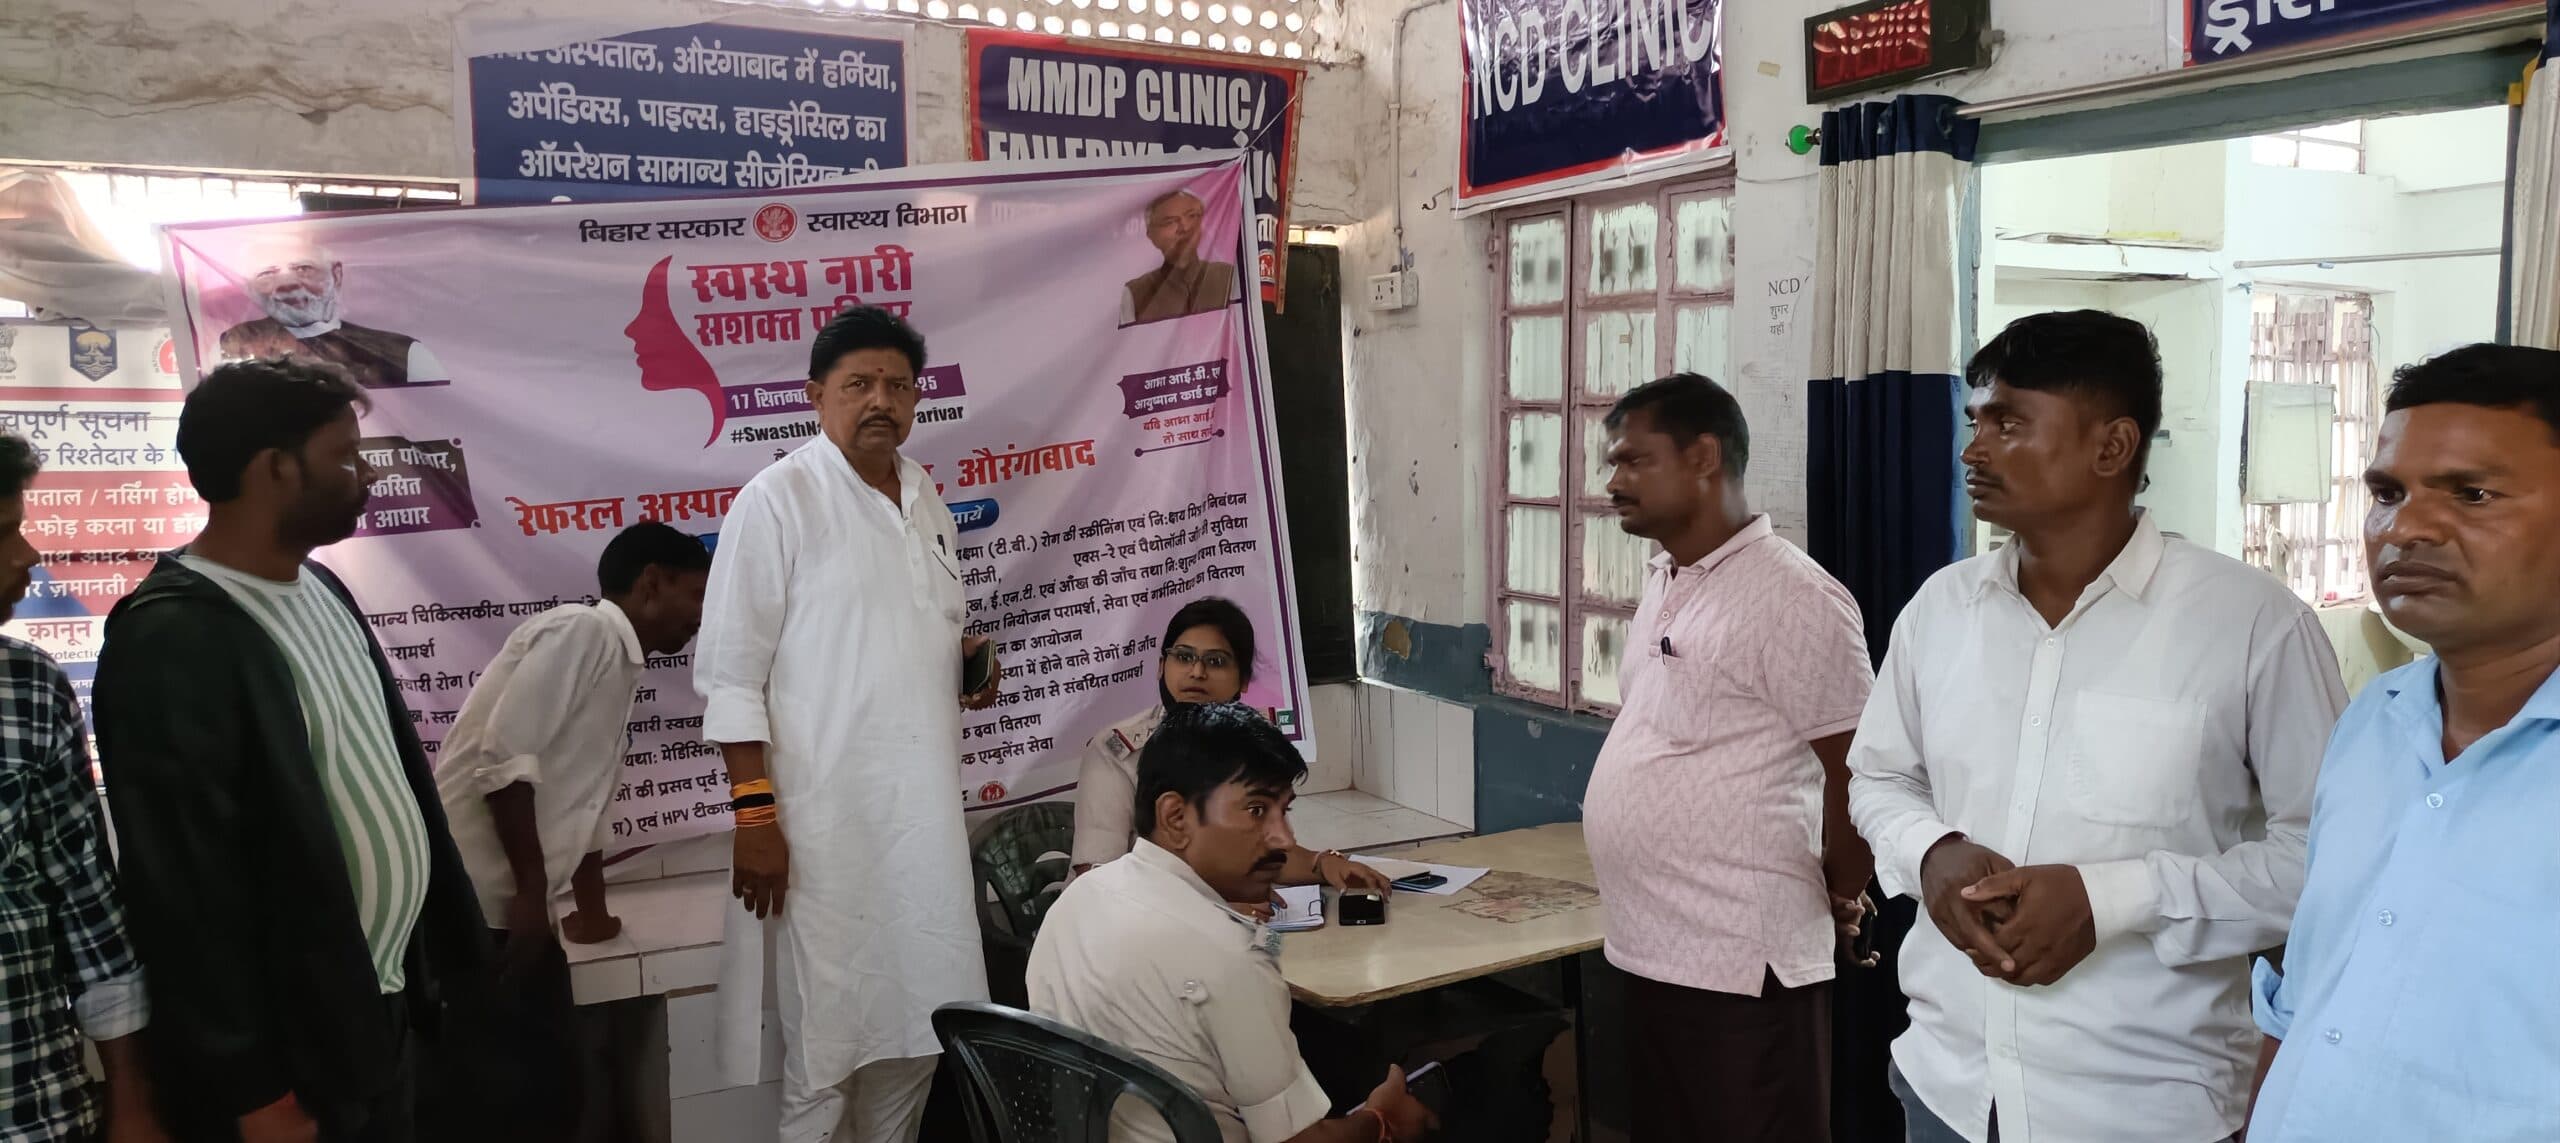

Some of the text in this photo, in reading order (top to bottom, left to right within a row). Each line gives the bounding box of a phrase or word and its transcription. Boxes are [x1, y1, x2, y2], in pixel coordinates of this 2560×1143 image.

[672, 36, 789, 81] औरंगाबाद
[795, 48, 819, 84] में
[821, 50, 897, 93] हर्निया,
[1471, 5, 1547, 120] NCD
[1008, 57, 1127, 118] MMDP
[638, 99, 726, 133] पाइल्स,
[733, 100, 851, 147] हाइड्रोसिल
[855, 115, 887, 142] का
[519, 140, 631, 181] ऑपरेशन
[637, 155, 728, 186] सामान्य
[579, 202, 968, 243] बिहार सरकार स्वास्थ्य विभाग
[687, 244, 914, 303] स्वस्थ नारी
[1768, 277, 1801, 297] NCD
[694, 308, 802, 347] सशक्त
[731, 393, 749, 410] 17
[78, 411, 152, 440] सूचना
[57, 442, 139, 466] रिश्तेदार
[144, 444, 165, 466] के
[105, 481, 159, 507] नर्सिंग
[505, 496, 625, 537] रेफरल
[958, 439, 1096, 488] औरंगाबाद
[86, 518, 137, 536] करना
[144, 519, 165, 535] या
[374, 506, 431, 529] आधार
[988, 536, 1038, 560] (टी.बी.)
[1040, 531, 1061, 548] रोग
[1063, 525, 1077, 543] की
[1078, 518, 1126, 541] स्क्रीनिंग
[1127, 513, 1147, 533] एवं
[1207, 491, 1248, 511] निबंधन
[1073, 543, 1116, 568] एक्स-रे
[1117, 540, 1137, 560] एवं
[1210, 514, 1249, 537] सुविधा
[48, 573, 128, 598] ज़मानती
[1039, 579, 1056, 599] एवं
[1092, 569, 1109, 586] की
[1111, 566, 1137, 584] जाँच
[1140, 563, 1163, 579] तथा
[1219, 539, 1257, 556] वितरण
[411, 599, 505, 625] चिकित्सकीय
[1003, 609, 1051, 630] नियोजन
[1054, 596, 1100, 619] परामर्श,
[1102, 593, 1129, 611] सेवा
[1131, 588, 1150, 608] एवं
[1207, 564, 1246, 581] वितरण
[1010, 638, 1027, 652] का
[1030, 628, 1083, 649] आयोजन
[1027, 657, 1037, 676] में
[1040, 653, 1063, 675] होने
[1066, 651, 1090, 668] वाले
[1095, 643, 1121, 663] रोगों
[1123, 640, 1136, 657] की
[435, 671, 463, 692] रोग
[1022, 685, 1046, 703] रोग
[1049, 682, 1061, 697] से
[1063, 673, 1110, 694] संबंधित
[1111, 660, 1145, 684] परामर्श
[973, 722, 997, 739] दवा
[999, 714, 1042, 734] वितरण
[978, 740, 1025, 765] एम्बुलेंस
[1027, 735, 1054, 752] सेवा
[635, 779, 655, 799] की
[657, 777, 693, 797] प्रसव
[695, 768, 718, 793] पूर्व
[636, 811, 659, 833] एवं
[662, 808, 689, 826] HPV
